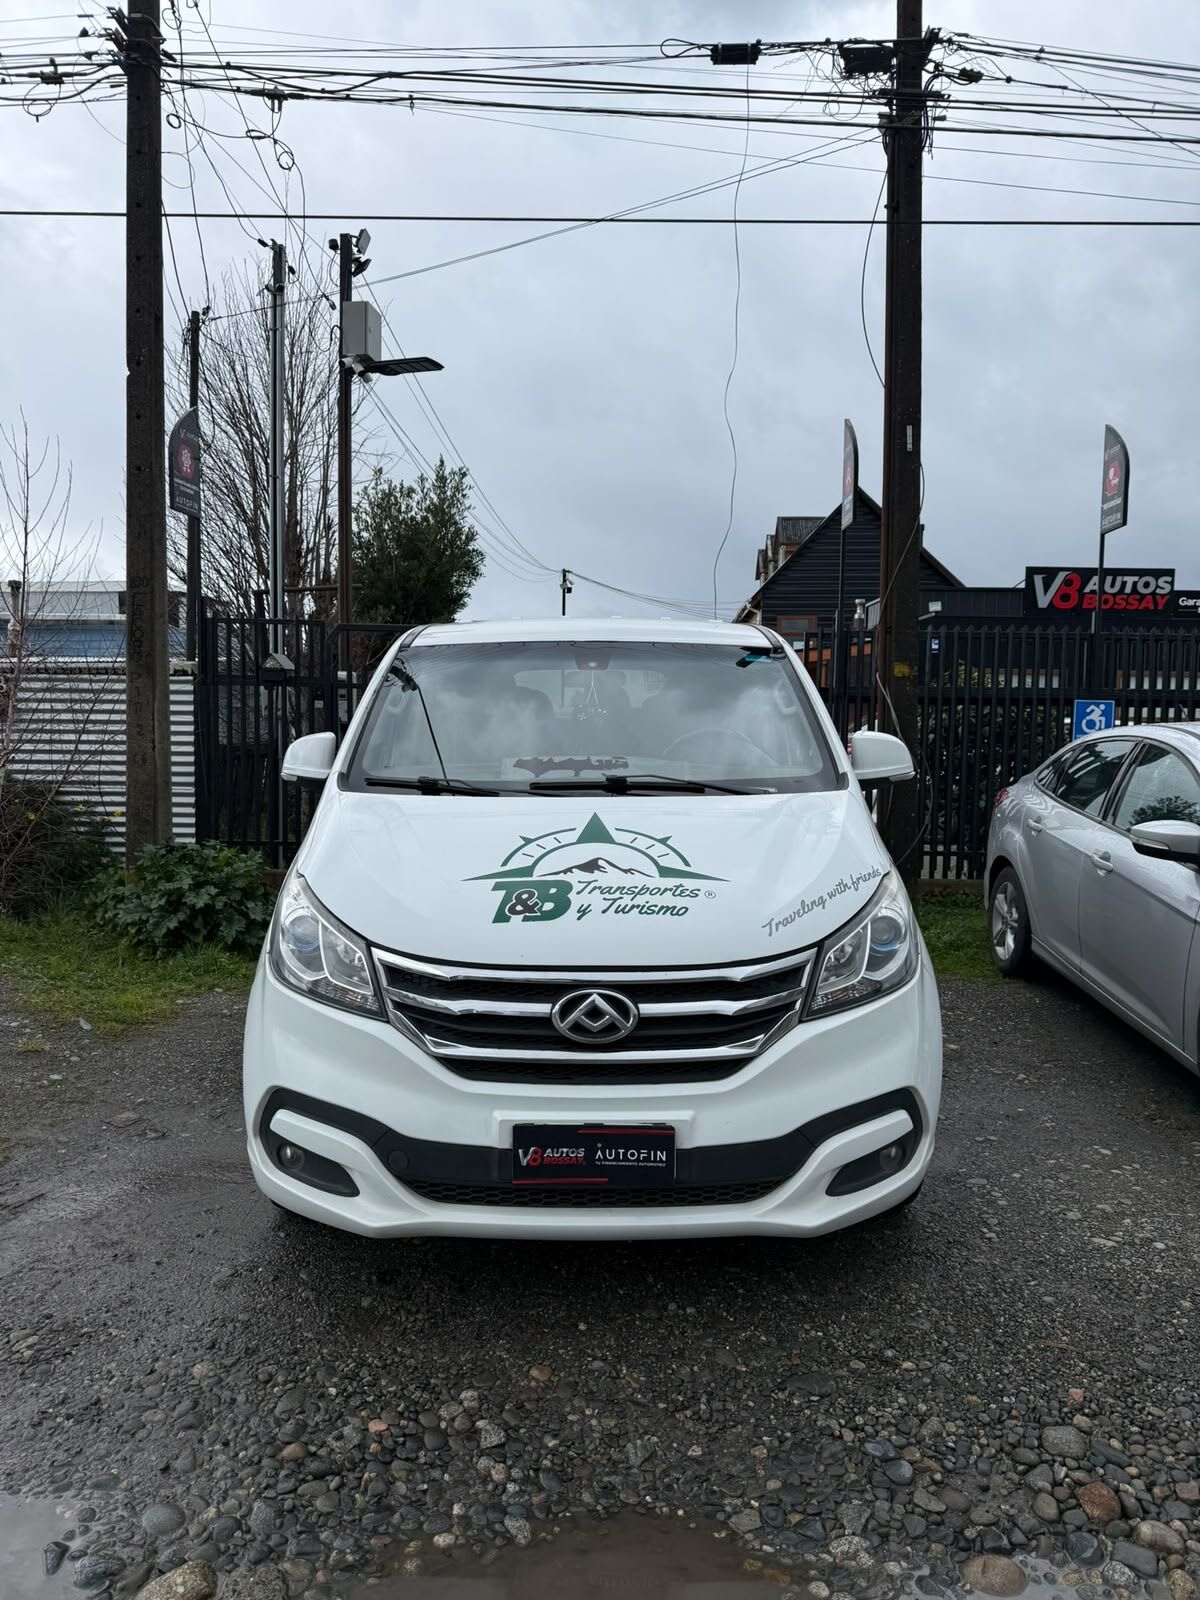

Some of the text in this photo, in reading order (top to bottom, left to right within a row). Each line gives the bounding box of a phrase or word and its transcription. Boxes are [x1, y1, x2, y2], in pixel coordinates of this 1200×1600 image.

[1033, 571, 1173, 609] V8 AUTOS
[1082, 594, 1169, 609] BOSSAY
[576, 879, 701, 900] Transportes
[576, 897, 690, 921] y Turismo
[761, 865, 882, 937] Traveling with friends
[518, 1146, 667, 1167] V8 AUTOS AUTOFIN
[543, 1157, 585, 1165] BOSSAY
